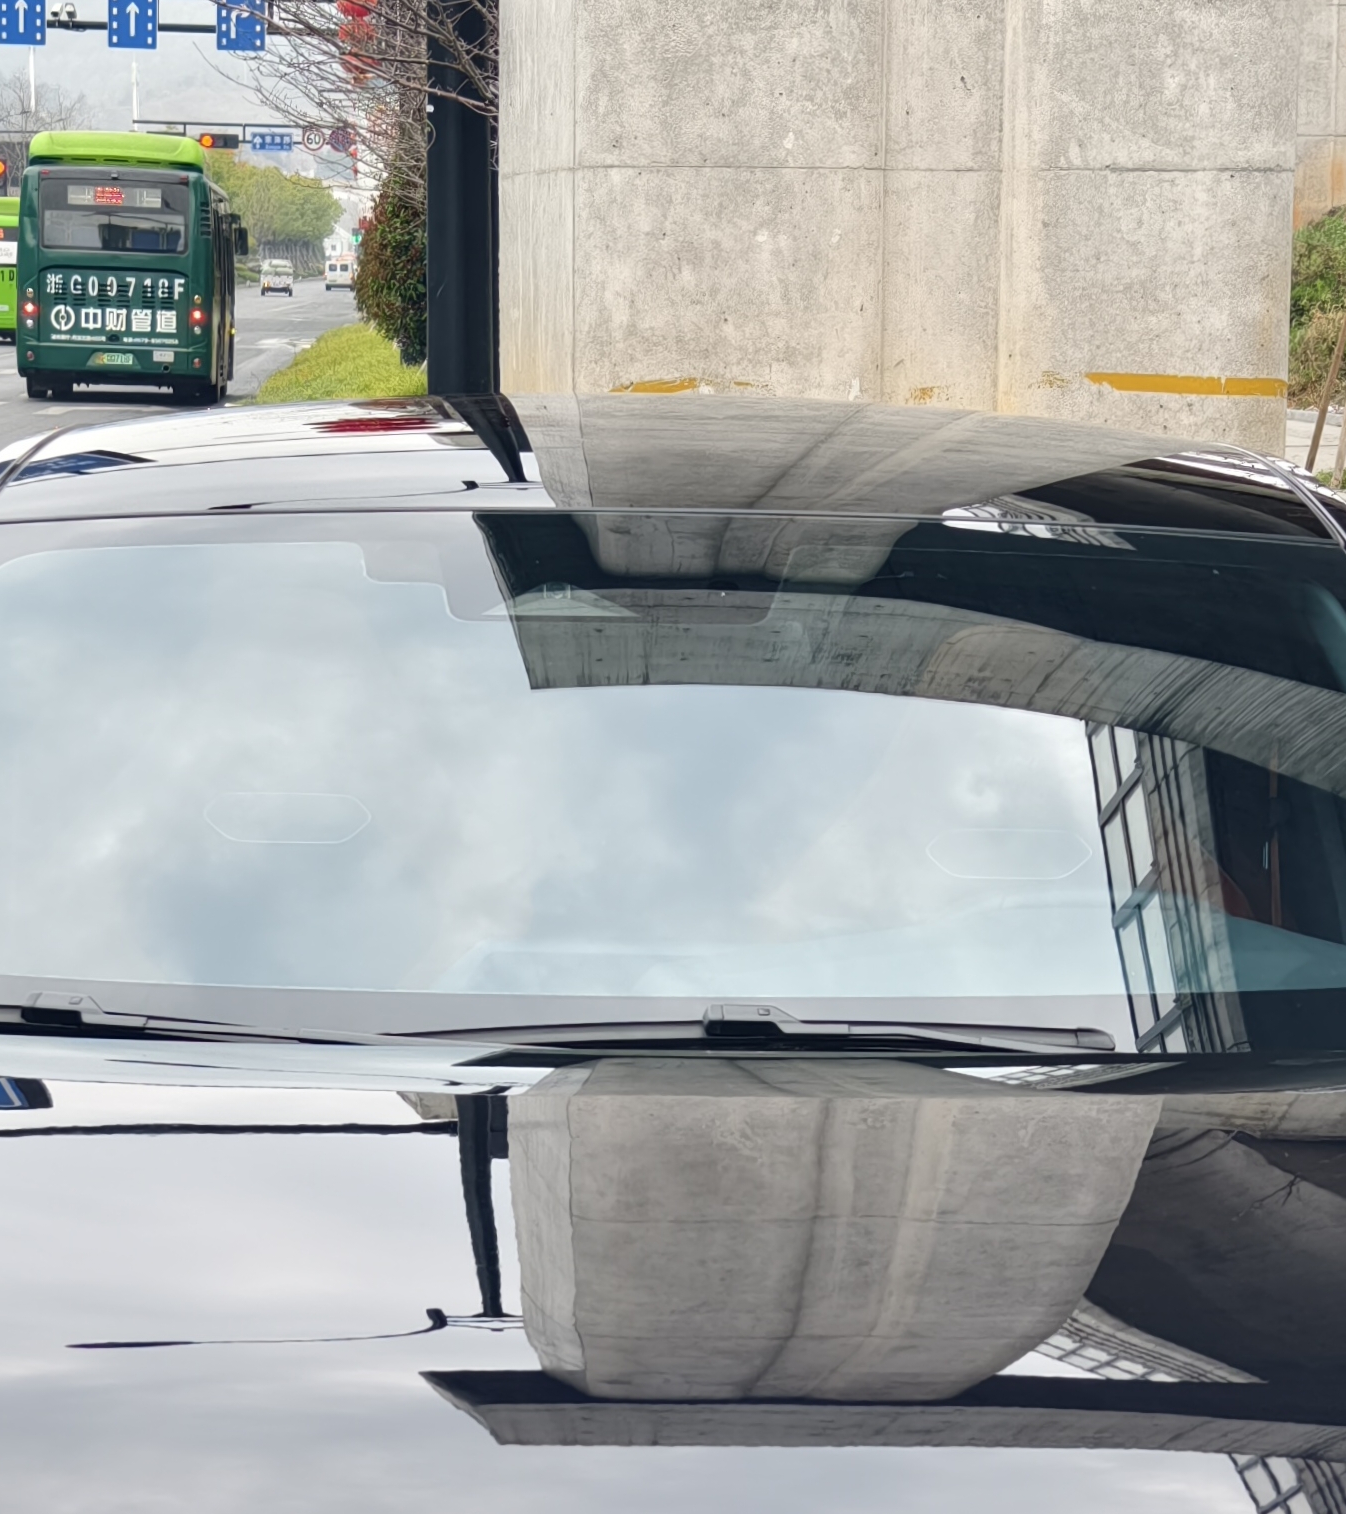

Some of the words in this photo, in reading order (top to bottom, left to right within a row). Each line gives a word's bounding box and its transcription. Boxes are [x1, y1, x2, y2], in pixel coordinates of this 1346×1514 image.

[306, 132, 321, 145] 60
[81, 307, 177, 333] 中财管道
